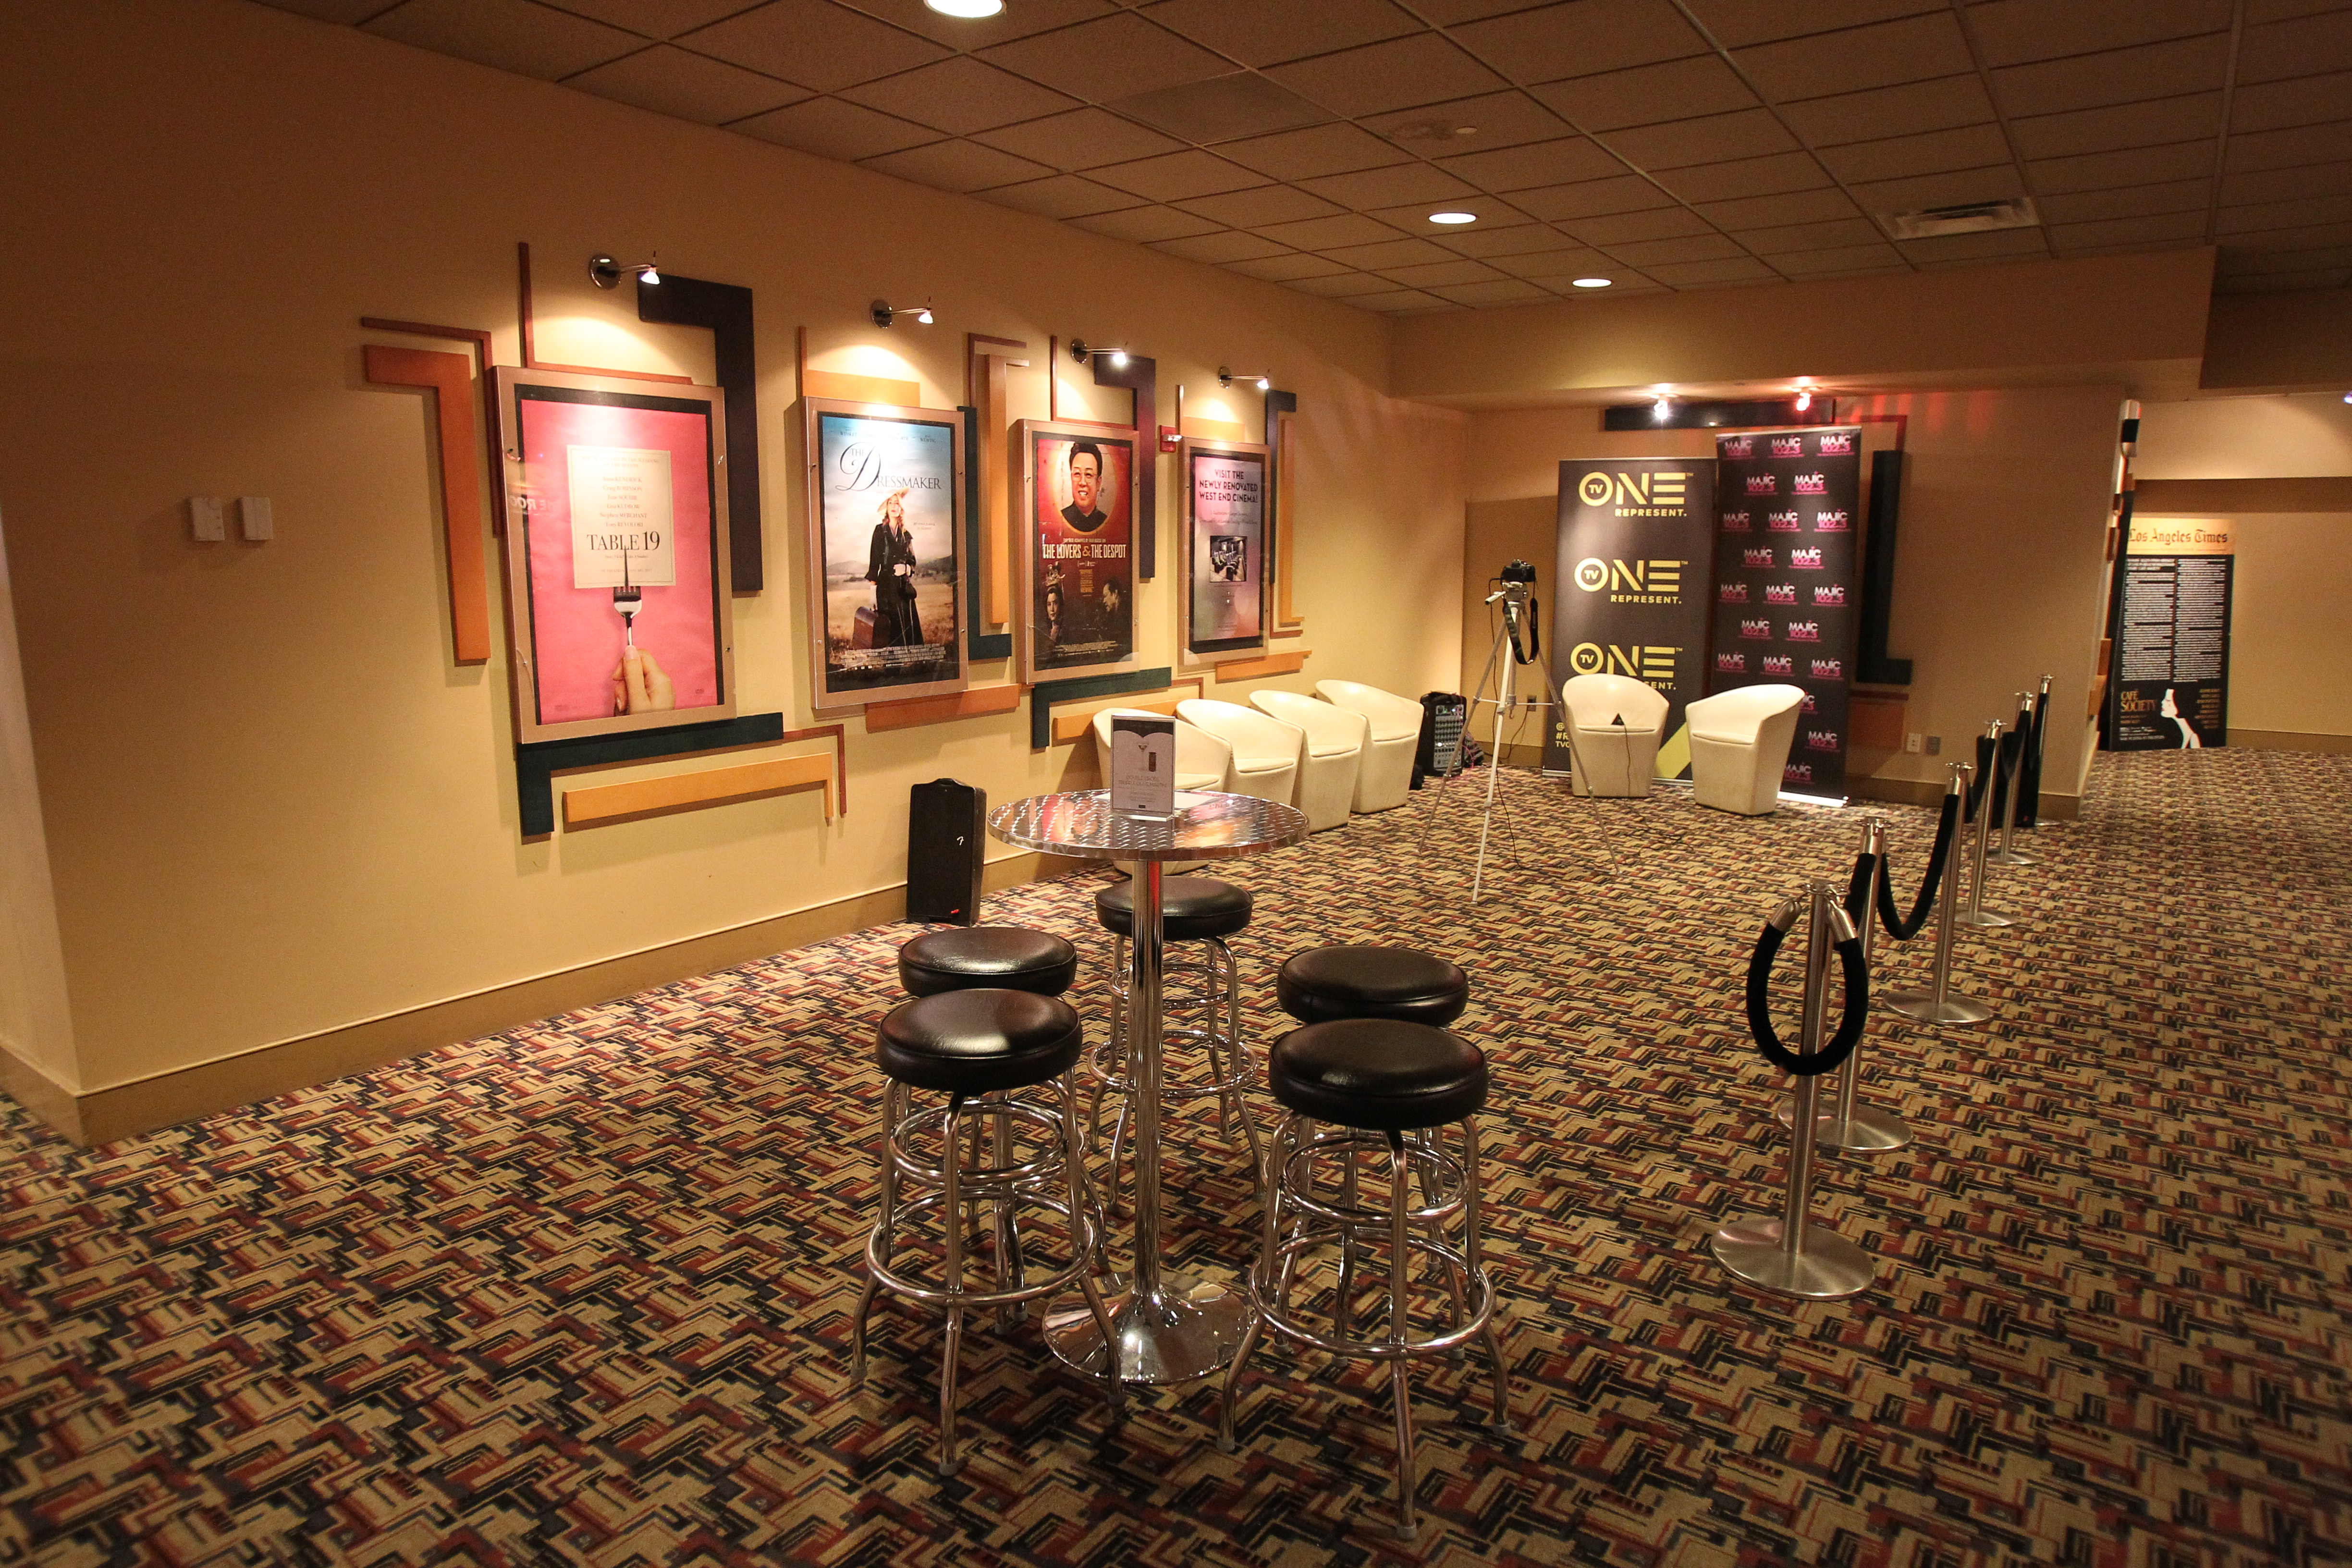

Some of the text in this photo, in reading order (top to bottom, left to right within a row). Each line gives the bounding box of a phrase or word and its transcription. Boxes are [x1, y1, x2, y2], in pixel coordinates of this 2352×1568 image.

[1771, 437, 1801, 447] MAJIC
[1820, 435, 1851, 445] MAJIC
[1821, 444, 1851, 453] 102.3
[1214, 469, 1244, 479] VISIT THE
[1747, 476, 1776, 485] MAJIC
[1794, 474, 1825, 484] MAJIC
[1199, 480, 1258, 491] NEWLY RENOVATED
[1579, 472, 1686, 506] ONE
[1589, 484, 1604, 493] TV
[1795, 483, 1825, 491] 102.3
[1199, 491, 1258, 503] WEST END CINEMA!
[1615, 508, 1687, 517] REPRESENT.
[1723, 513, 1750, 521] MAJIC
[1769, 512, 1799, 521] MAJIC
[1817, 512, 1848, 521] MAJIC
[587, 531, 660, 550] TABLE 19
[2129, 528, 2227, 545] Los Angeles Times
[1042, 544, 1127, 559] THE LOVERS & THE DESPOT
[1744, 549, 1773, 557] MAJIC
[1791, 549, 1822, 558] MAJIC
[1792, 557, 1821, 565] 102.3
[1574, 557, 1680, 592] ONE
[1584, 570, 1599, 579] TV
[1721, 584, 1747, 593] MAJIC
[1765, 585, 1795, 594] MAJIC
[1814, 586, 1844, 596] MAJIC
[1611, 594, 1682, 604] REPRESENT.
[1741, 620, 1770, 629] MAJIC
[1788, 622, 1818, 631] MAJIC
[1570, 642, 1675, 678] ONE
[1580, 655, 1594, 663] TV
[1718, 653, 1744, 662] MAJIC
[1764, 656, 1792, 665] MAJIC
[1812, 659, 1841, 669] MAJIC
[1808, 731, 1838, 741] MAJIC
